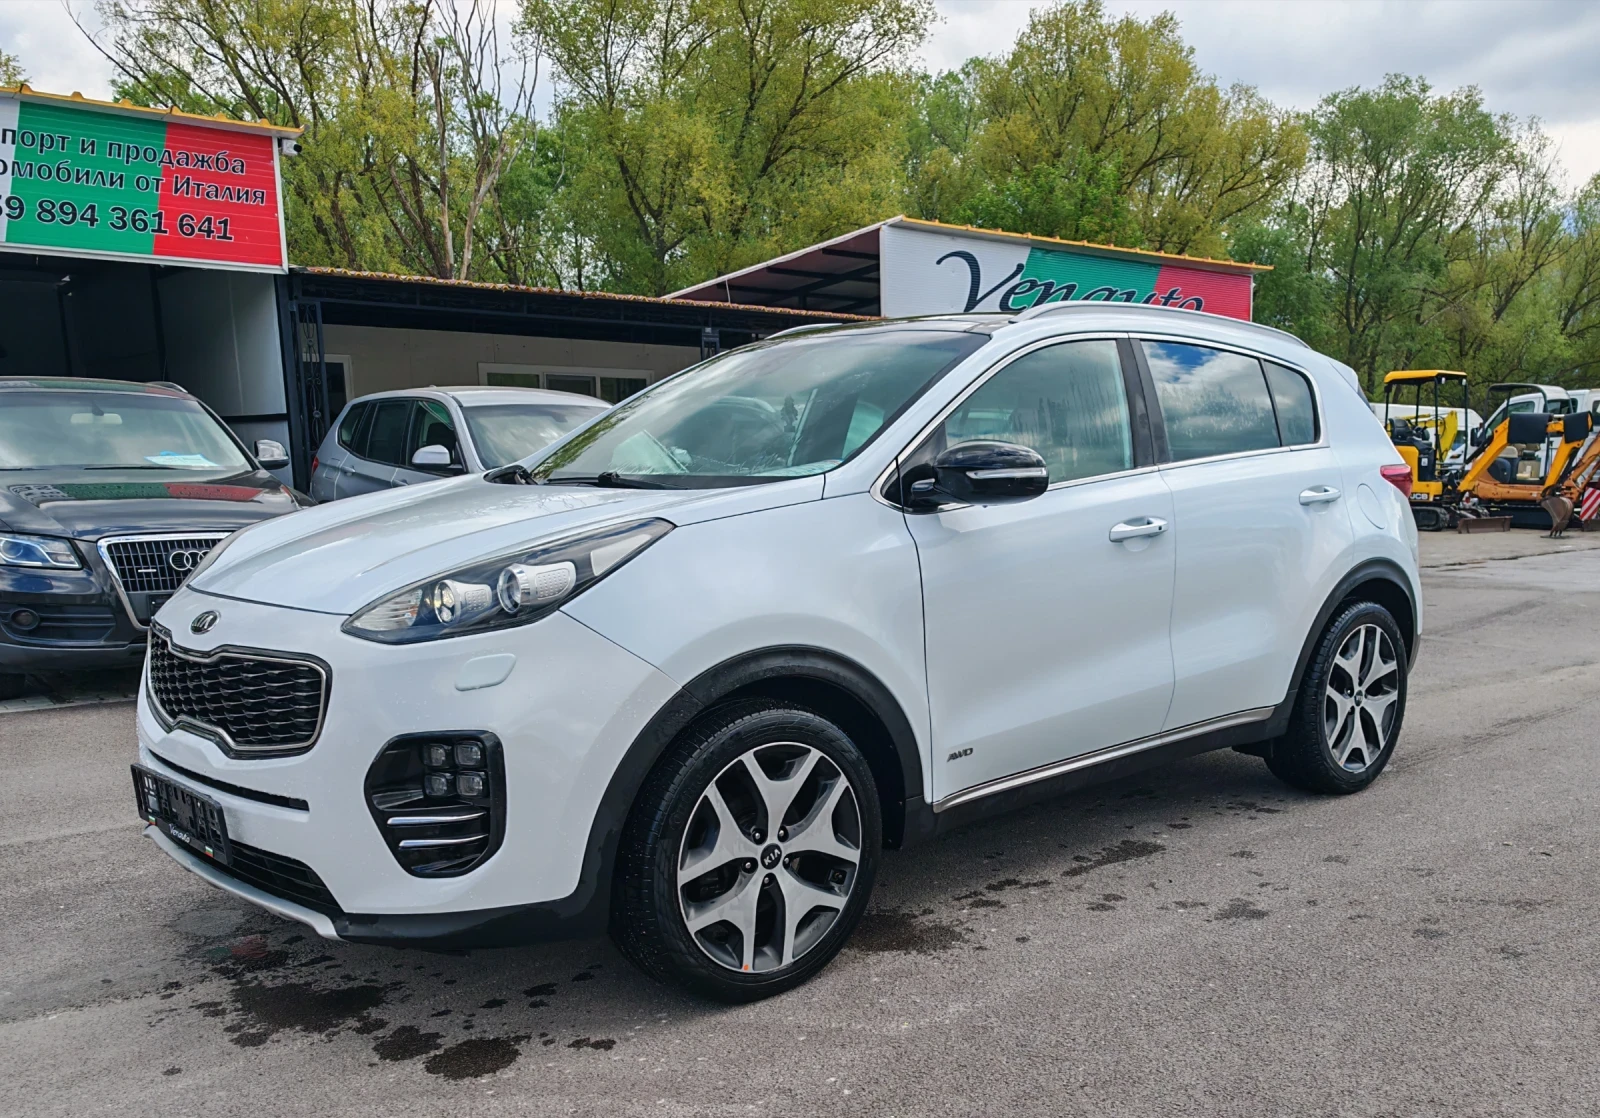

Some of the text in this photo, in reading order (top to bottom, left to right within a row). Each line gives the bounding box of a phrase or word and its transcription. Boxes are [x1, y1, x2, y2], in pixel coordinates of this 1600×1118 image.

[1, 127, 246, 175] порт и продажба
[135, 175, 165, 194] от
[173, 175, 266, 205] Италия
[0, 194, 234, 242] 9 894 361 641
[946, 747, 974, 763] AWD
[763, 848, 781, 866] KIA
